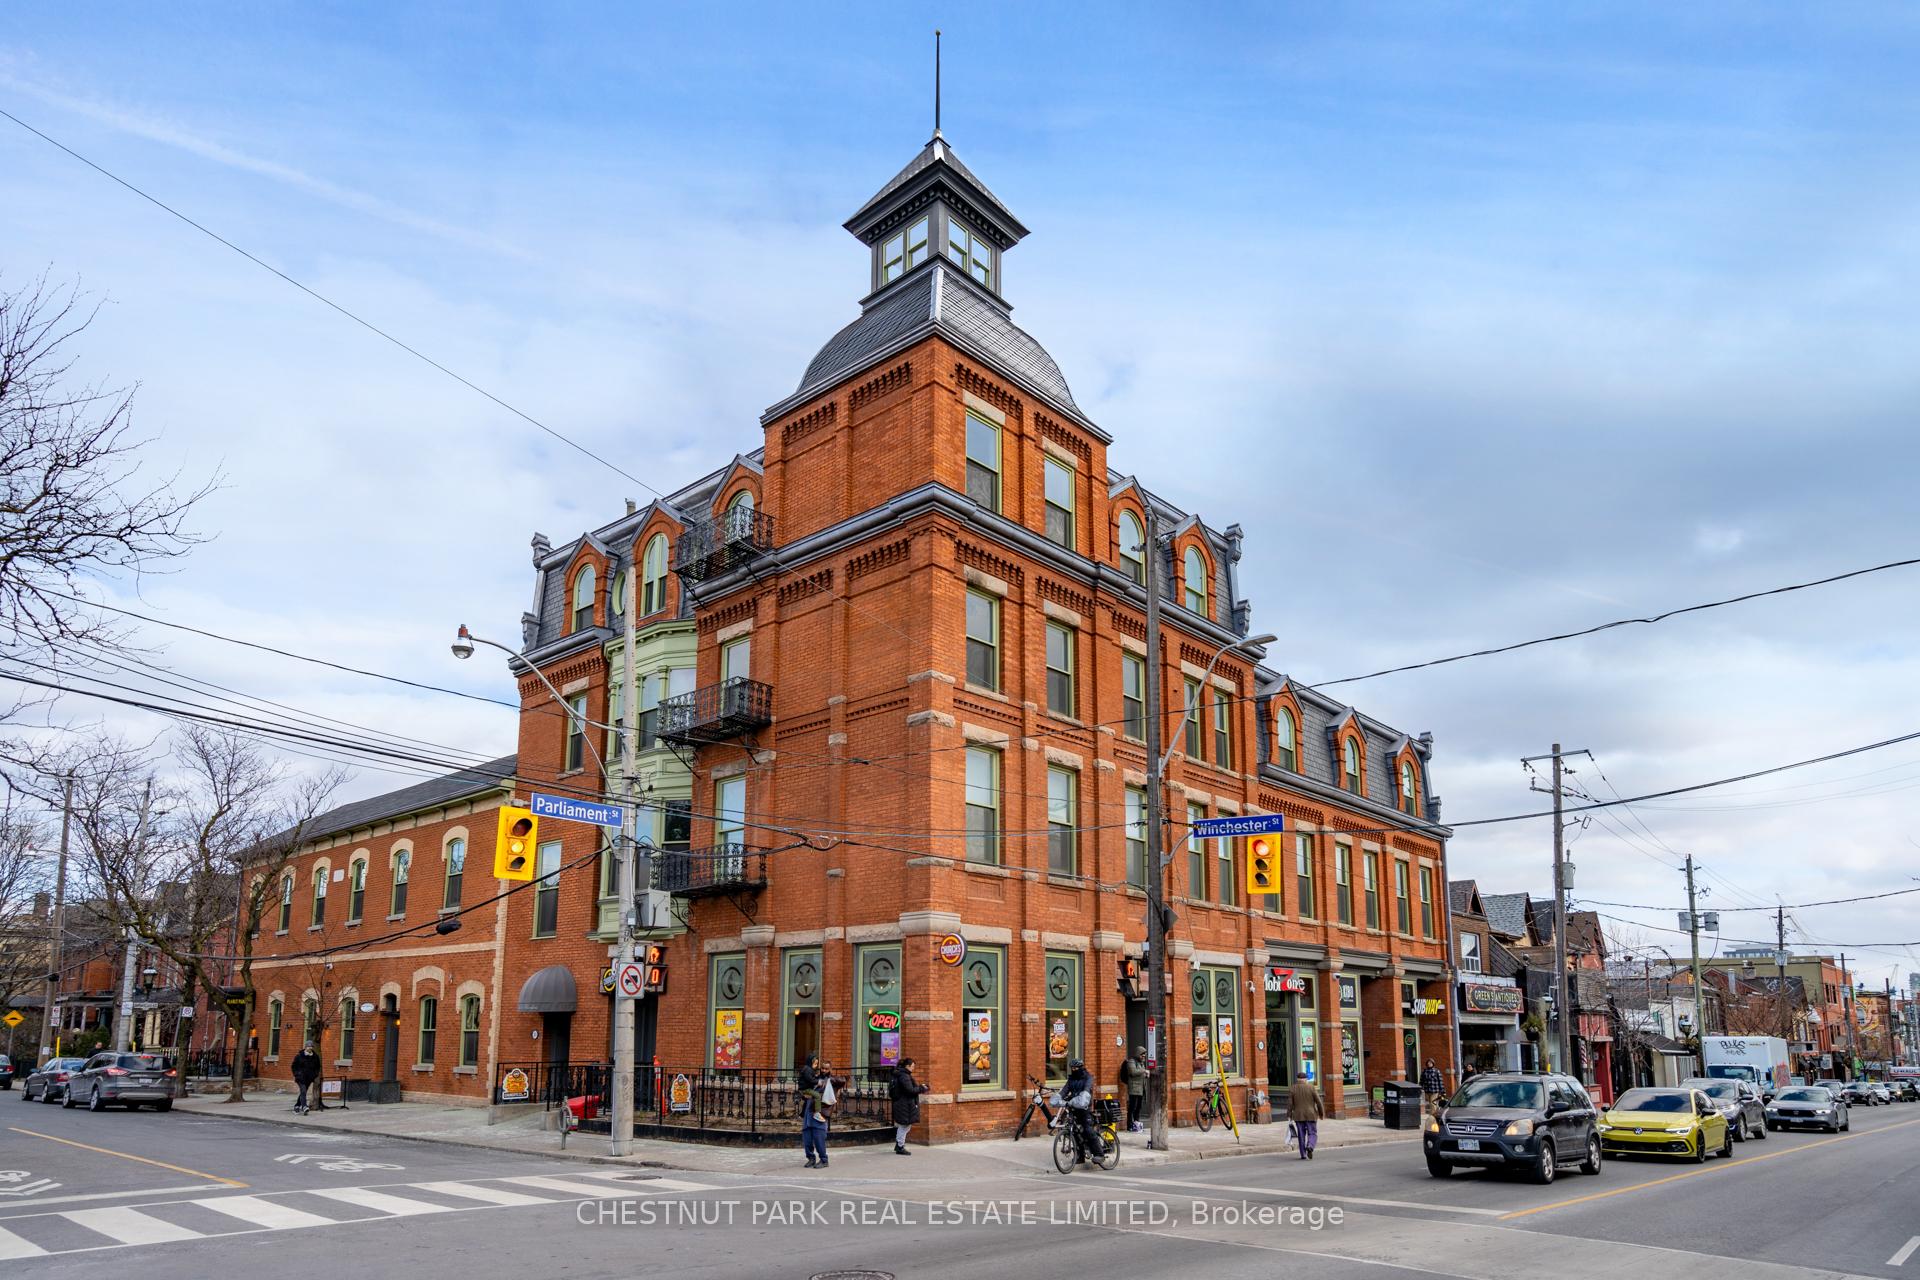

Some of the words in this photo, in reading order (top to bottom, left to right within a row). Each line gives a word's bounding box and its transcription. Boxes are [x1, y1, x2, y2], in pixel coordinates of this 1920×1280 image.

[536, 797, 608, 822] Parliament
[612, 810, 619, 818] St
[1197, 819, 1268, 836] Winchester
[1272, 817, 1280, 825] St
[1411, 999, 1441, 1015] SUBWAY
[871, 1014, 897, 1029] OPEN
